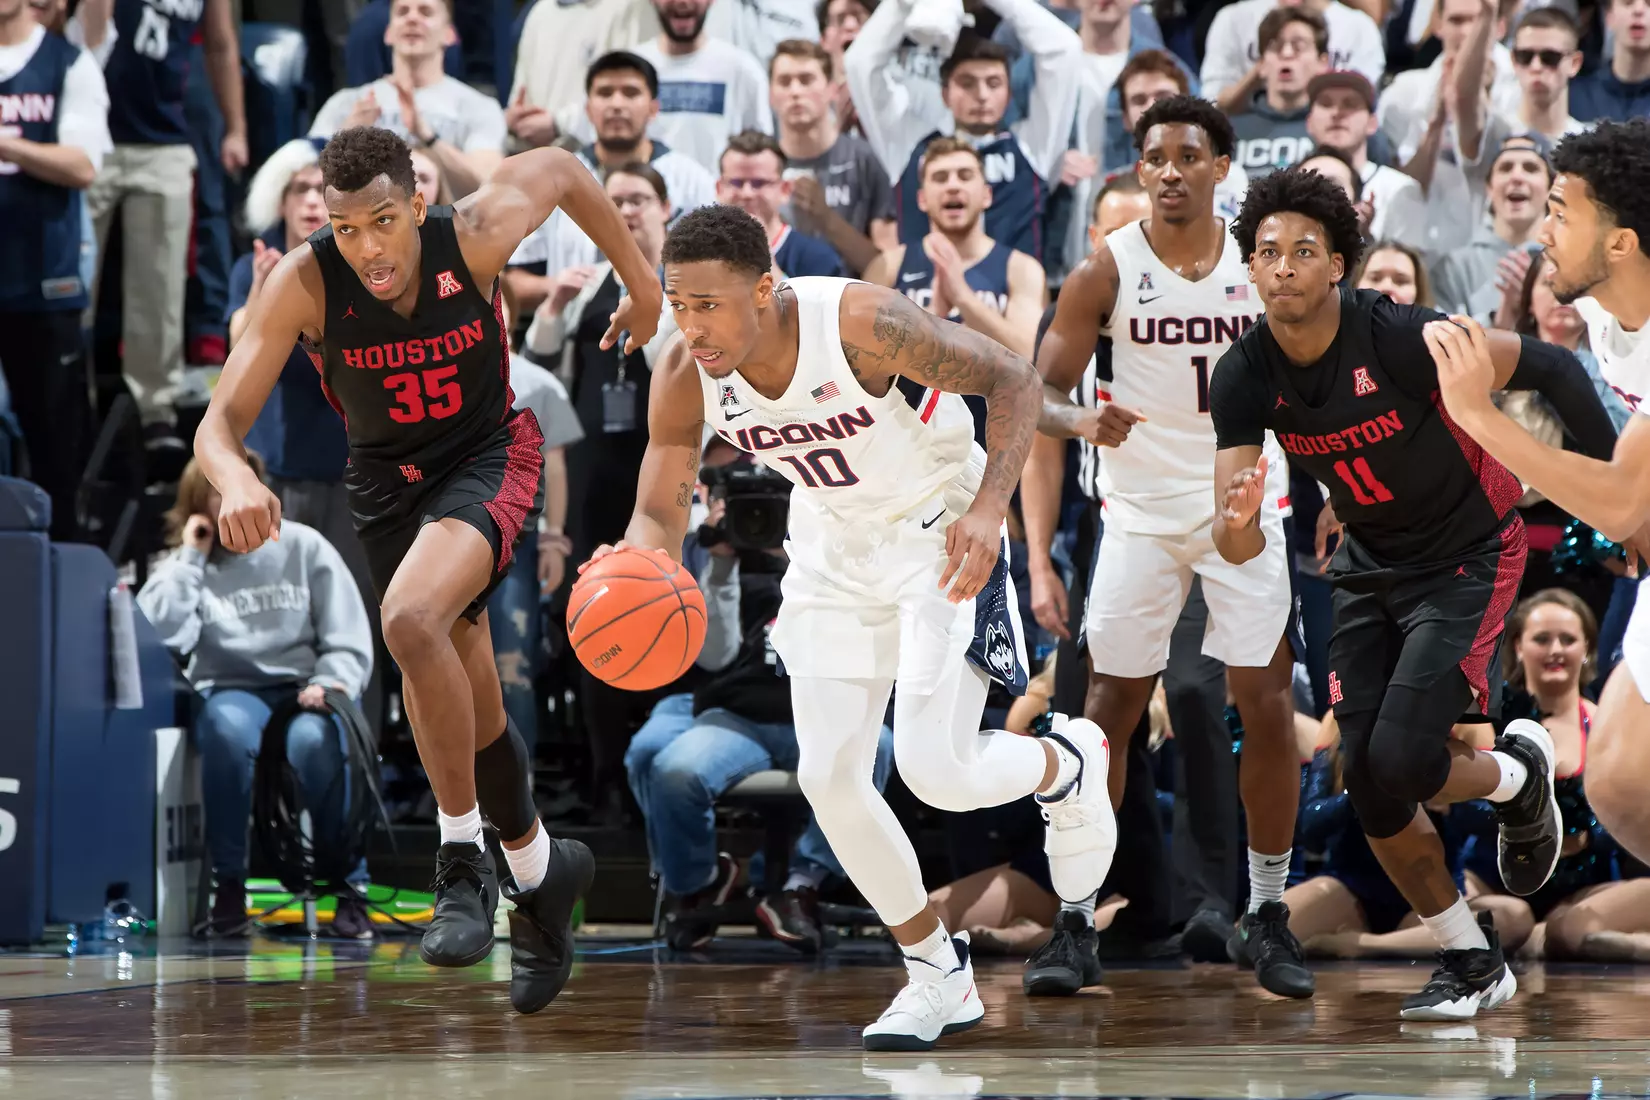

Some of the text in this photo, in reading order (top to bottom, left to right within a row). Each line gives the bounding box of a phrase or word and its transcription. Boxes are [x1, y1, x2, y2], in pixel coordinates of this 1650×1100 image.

[341, 318, 485, 370] HOUSTON
[382, 363, 464, 424] 35
[718, 405, 876, 451] UCONN
[1278, 408, 1405, 456] HOUSTON
[776, 447, 861, 488] 10
[1332, 456, 1395, 506] 11
[590, 643, 623, 669] UCONN
